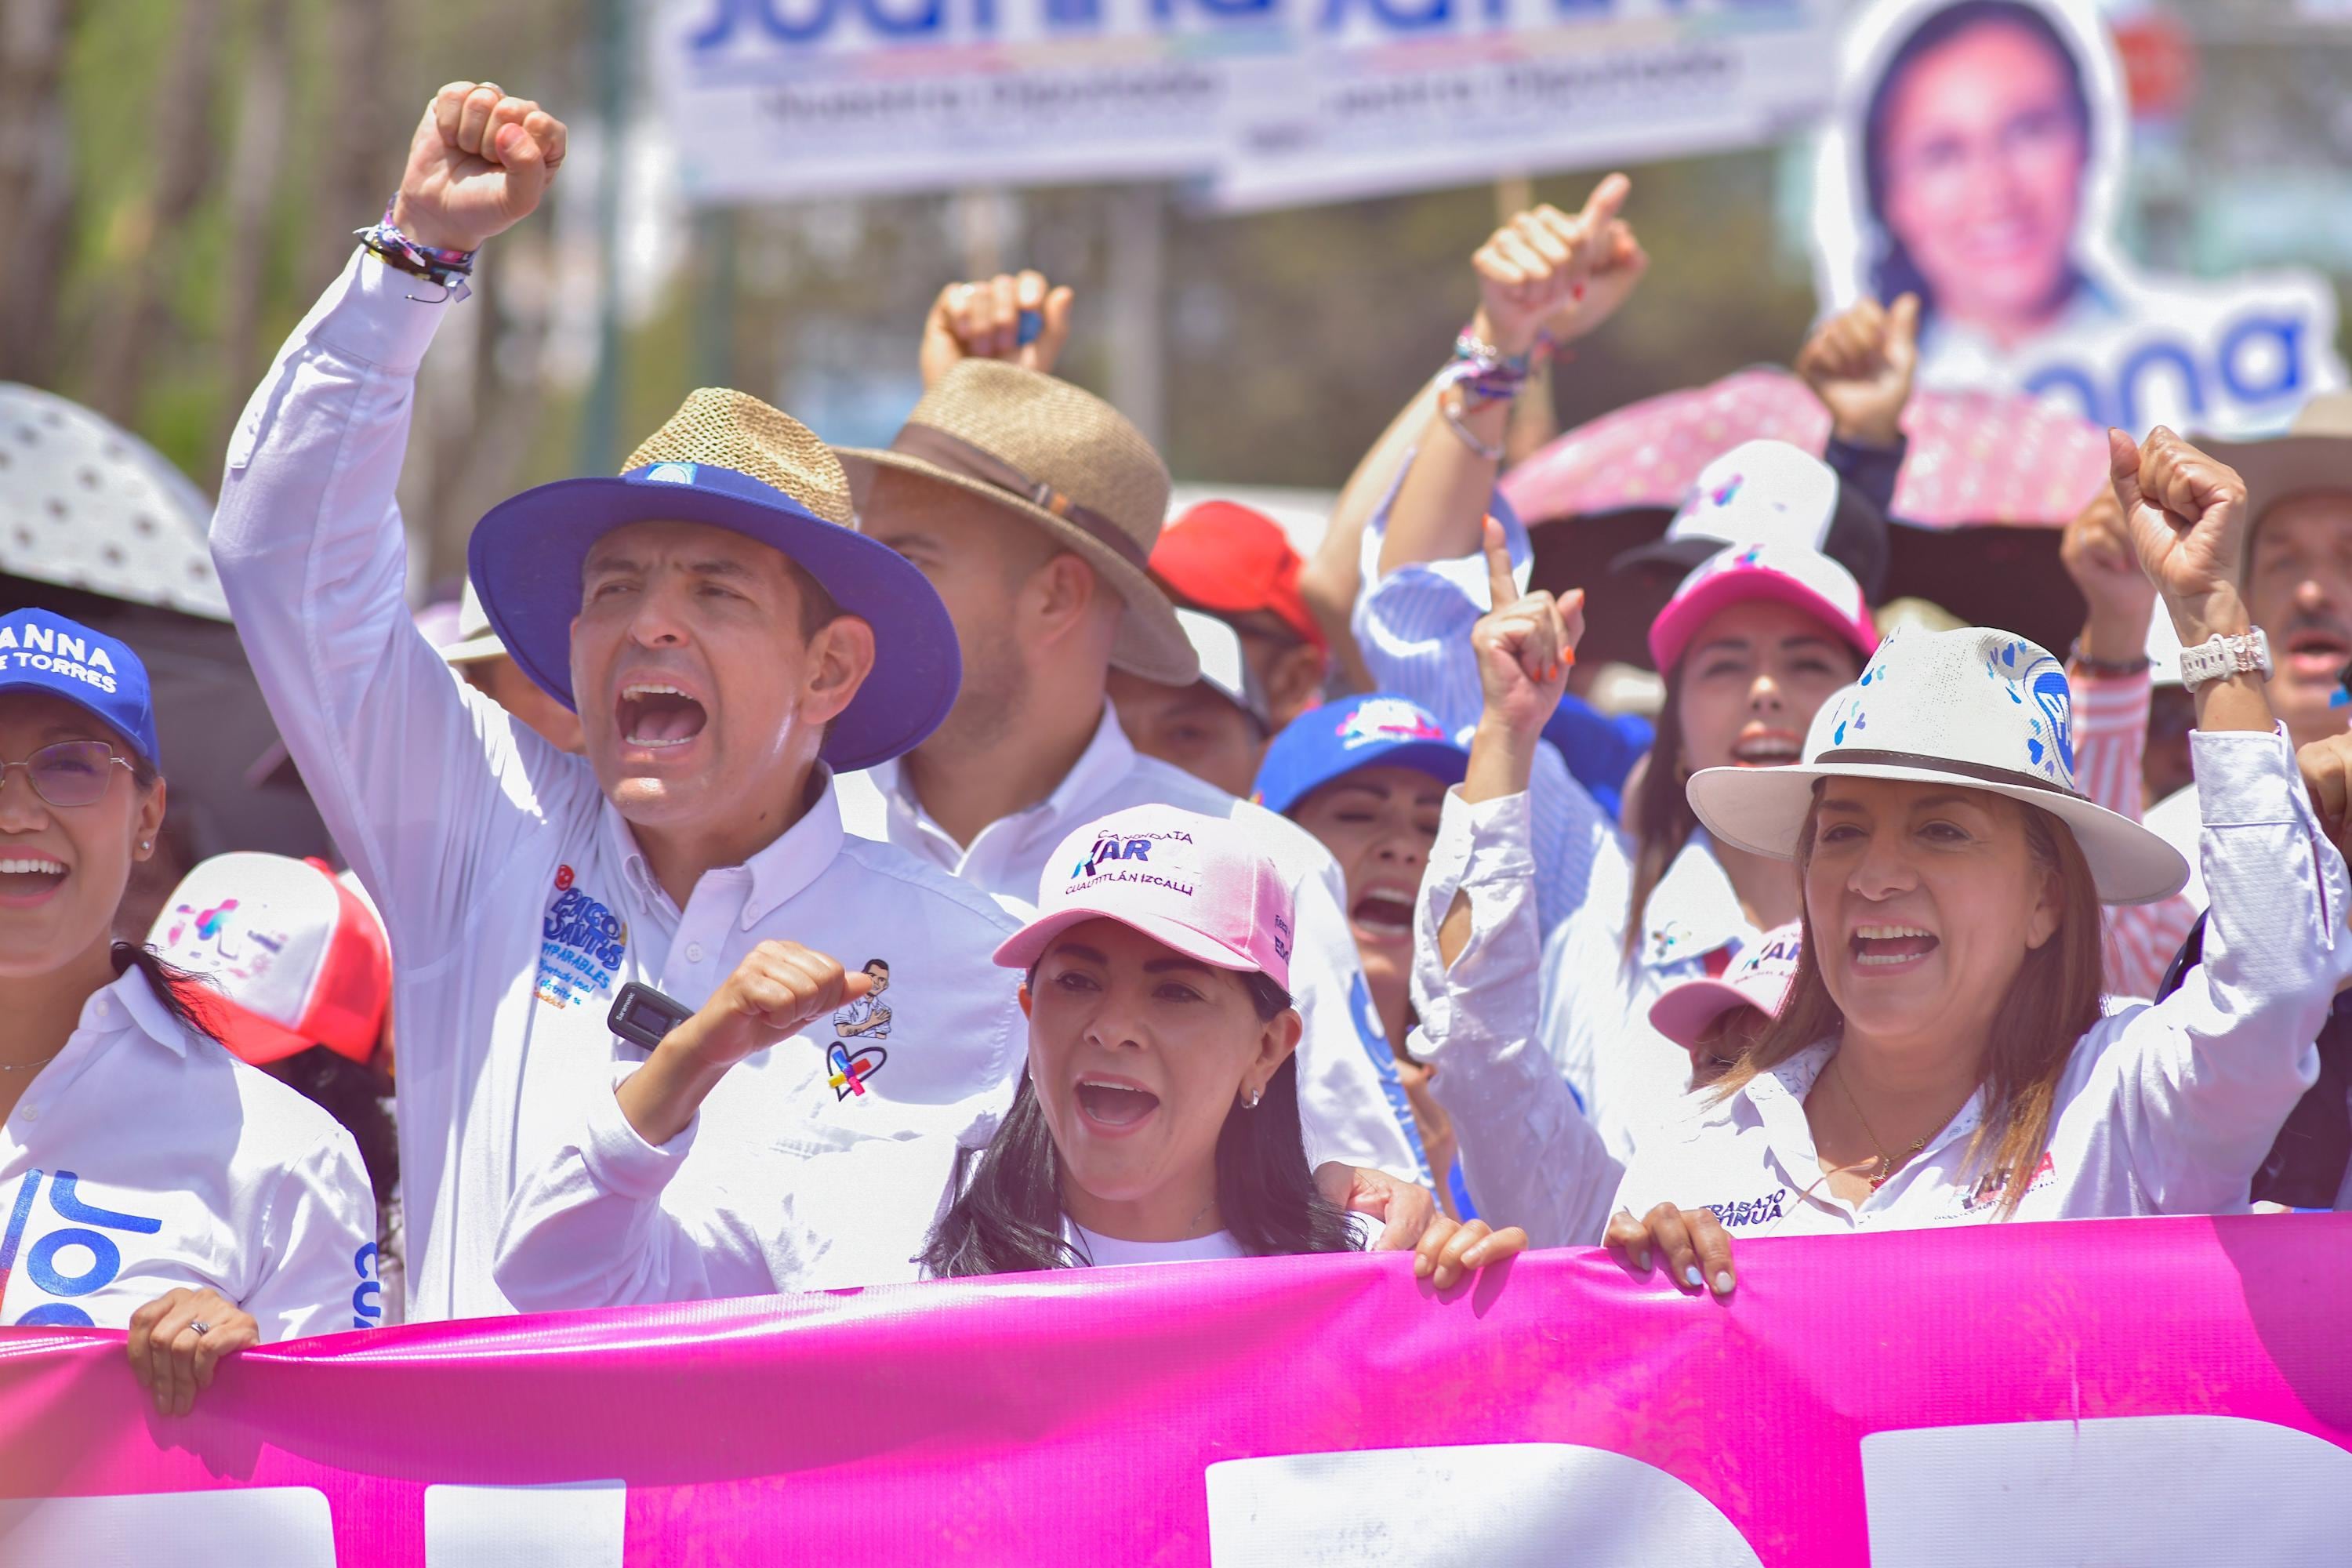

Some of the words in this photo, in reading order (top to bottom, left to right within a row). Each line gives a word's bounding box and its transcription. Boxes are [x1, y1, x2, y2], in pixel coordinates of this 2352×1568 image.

[0, 623, 116, 675] ANNA
[13, 652, 117, 694] TORRES
[1141, 873, 1194, 897] IZCALLI
